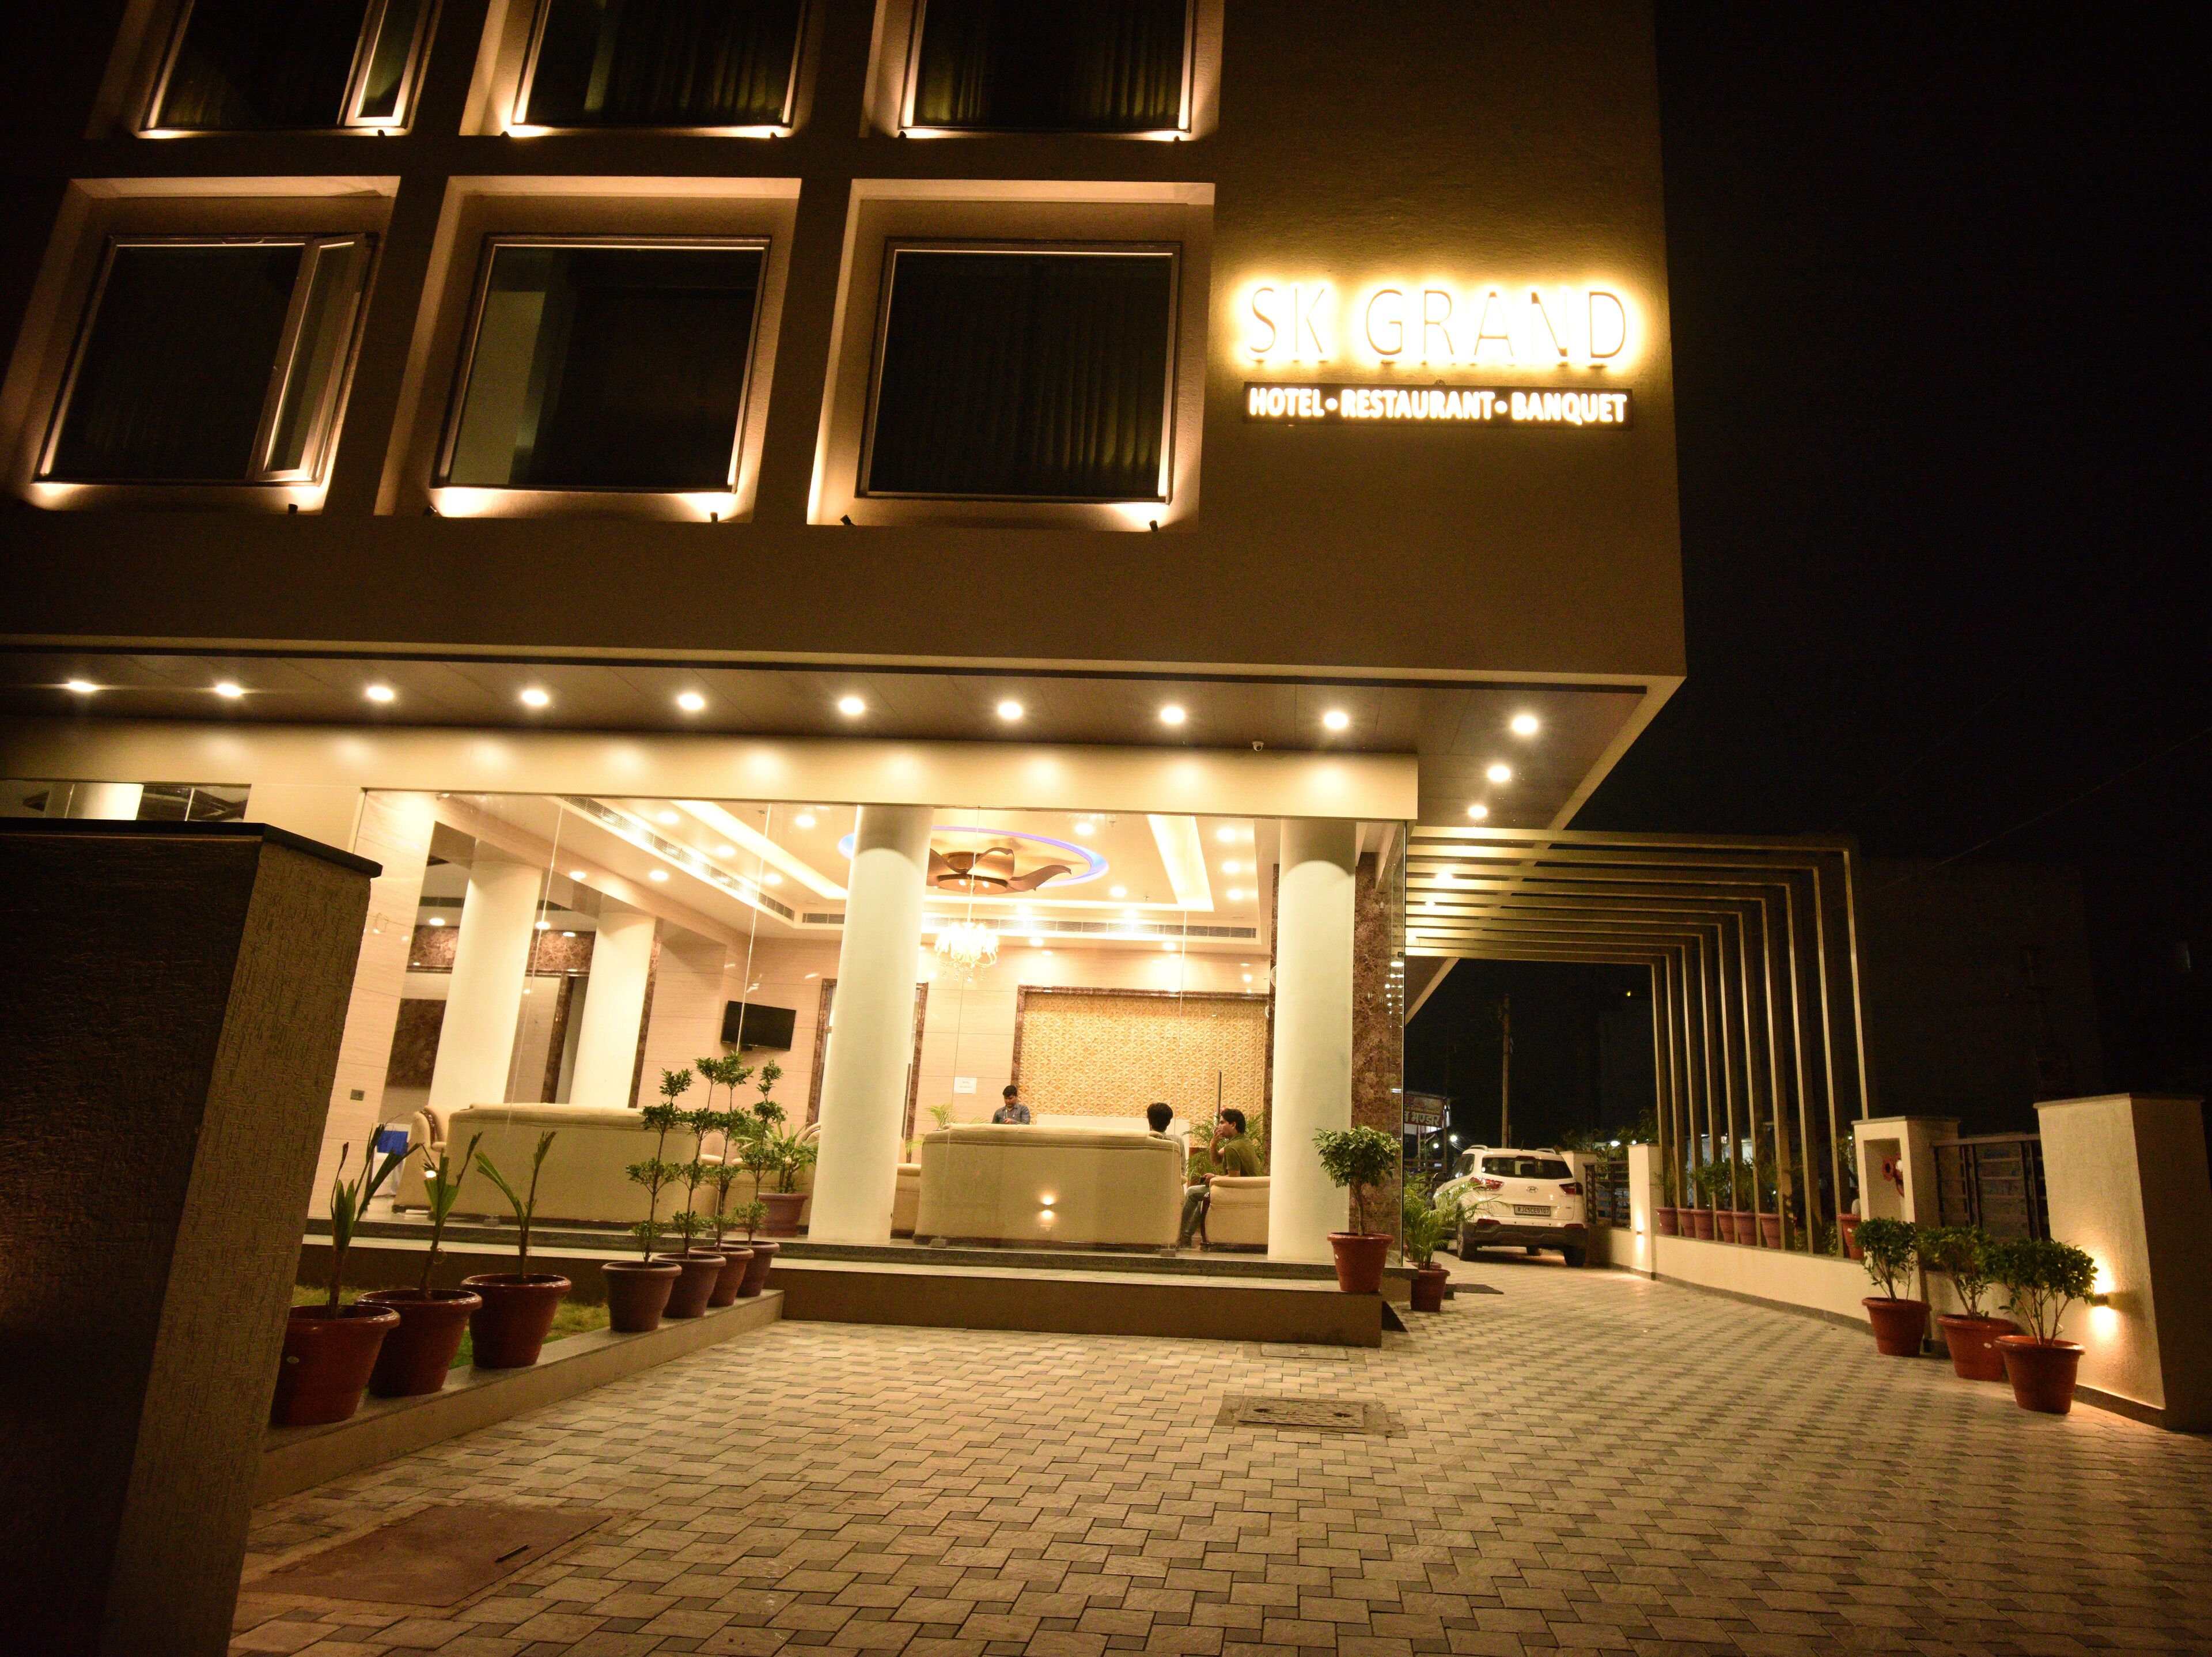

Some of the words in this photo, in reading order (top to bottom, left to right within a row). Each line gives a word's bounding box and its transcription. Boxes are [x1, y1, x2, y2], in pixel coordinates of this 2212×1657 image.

[1248, 286, 1325, 354] SK
[1365, 287, 1627, 359] GRAND
[1249, 387, 1325, 417] HOTEL
[1340, 389, 1496, 419] RESTAURANT
[1512, 392, 1628, 425] BANQUET
